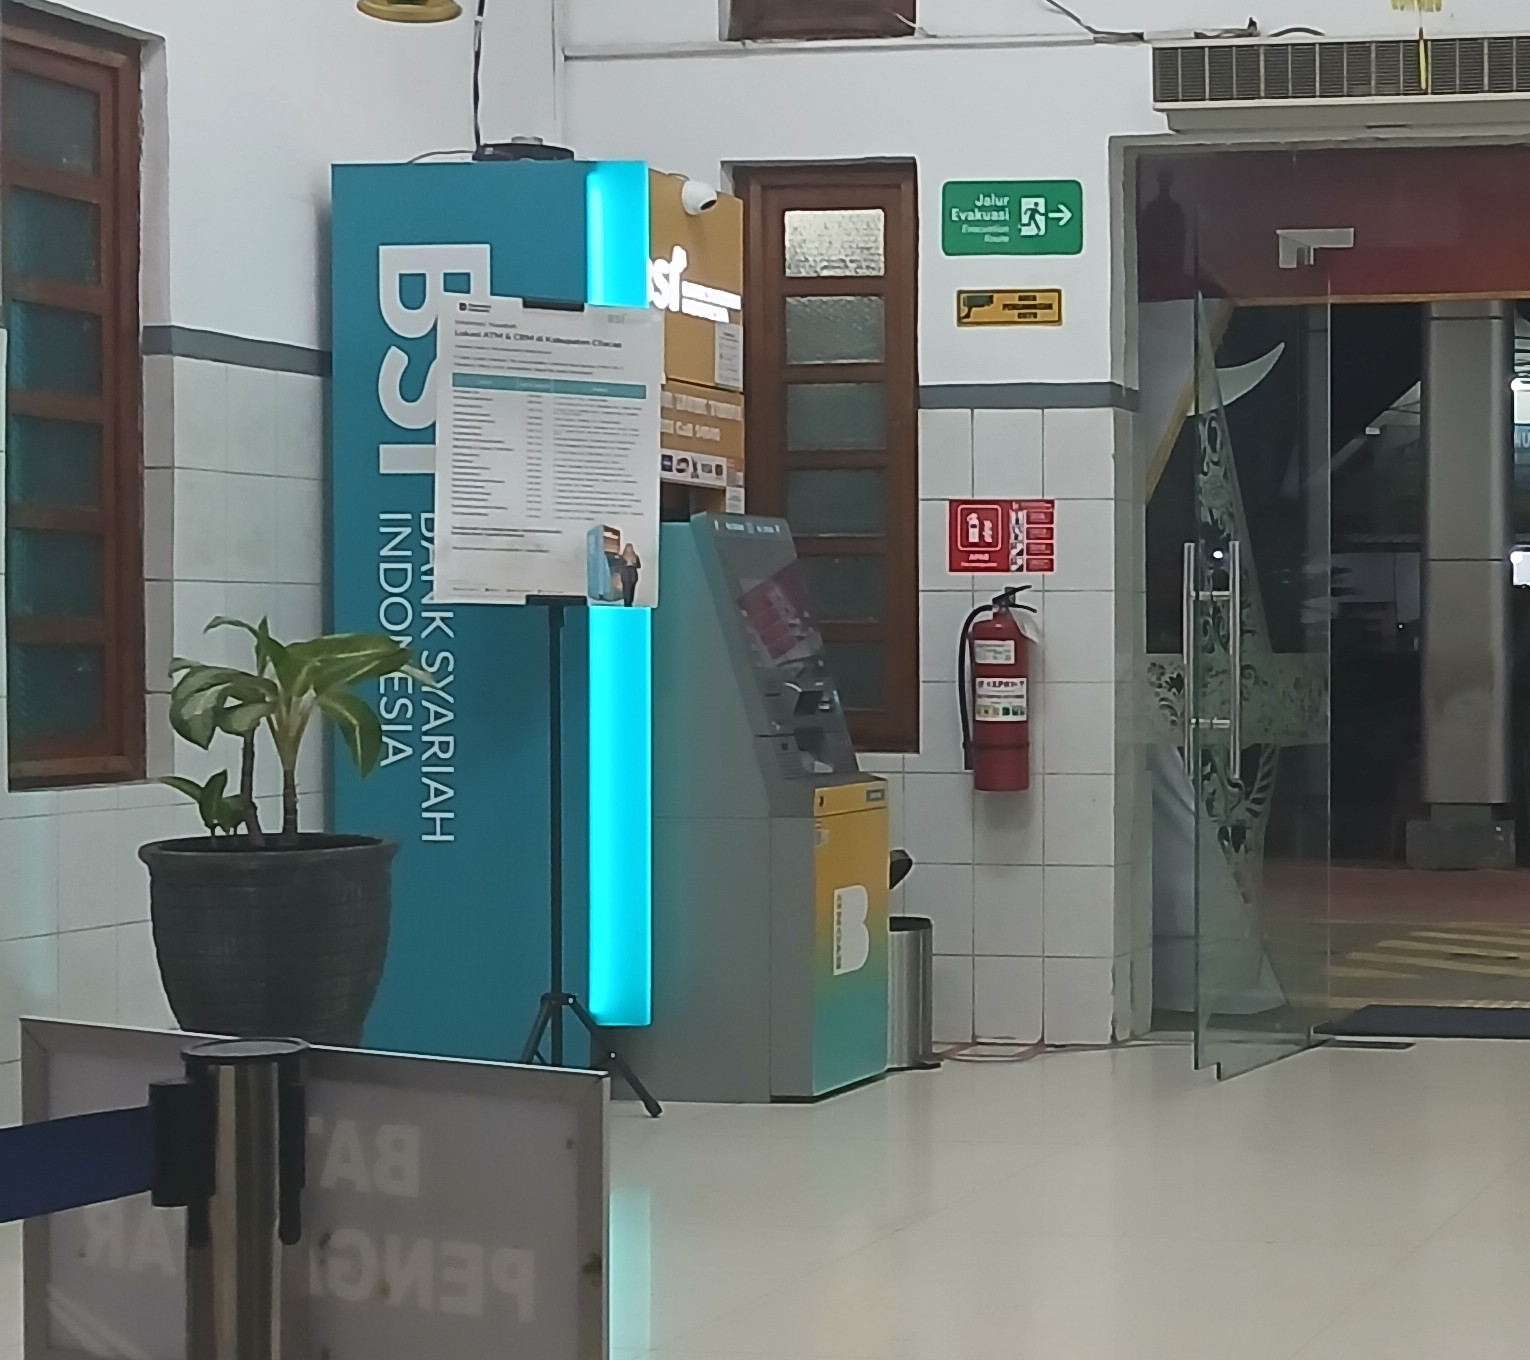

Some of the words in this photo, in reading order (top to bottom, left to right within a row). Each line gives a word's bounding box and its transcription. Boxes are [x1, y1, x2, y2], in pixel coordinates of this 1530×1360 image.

[951, 207, 1010, 221] Evakuasi
[975, 193, 1010, 206] Jalur
[379, 513, 413, 767] INDOESIA
[421, 650, 455, 841] SYARIAH
